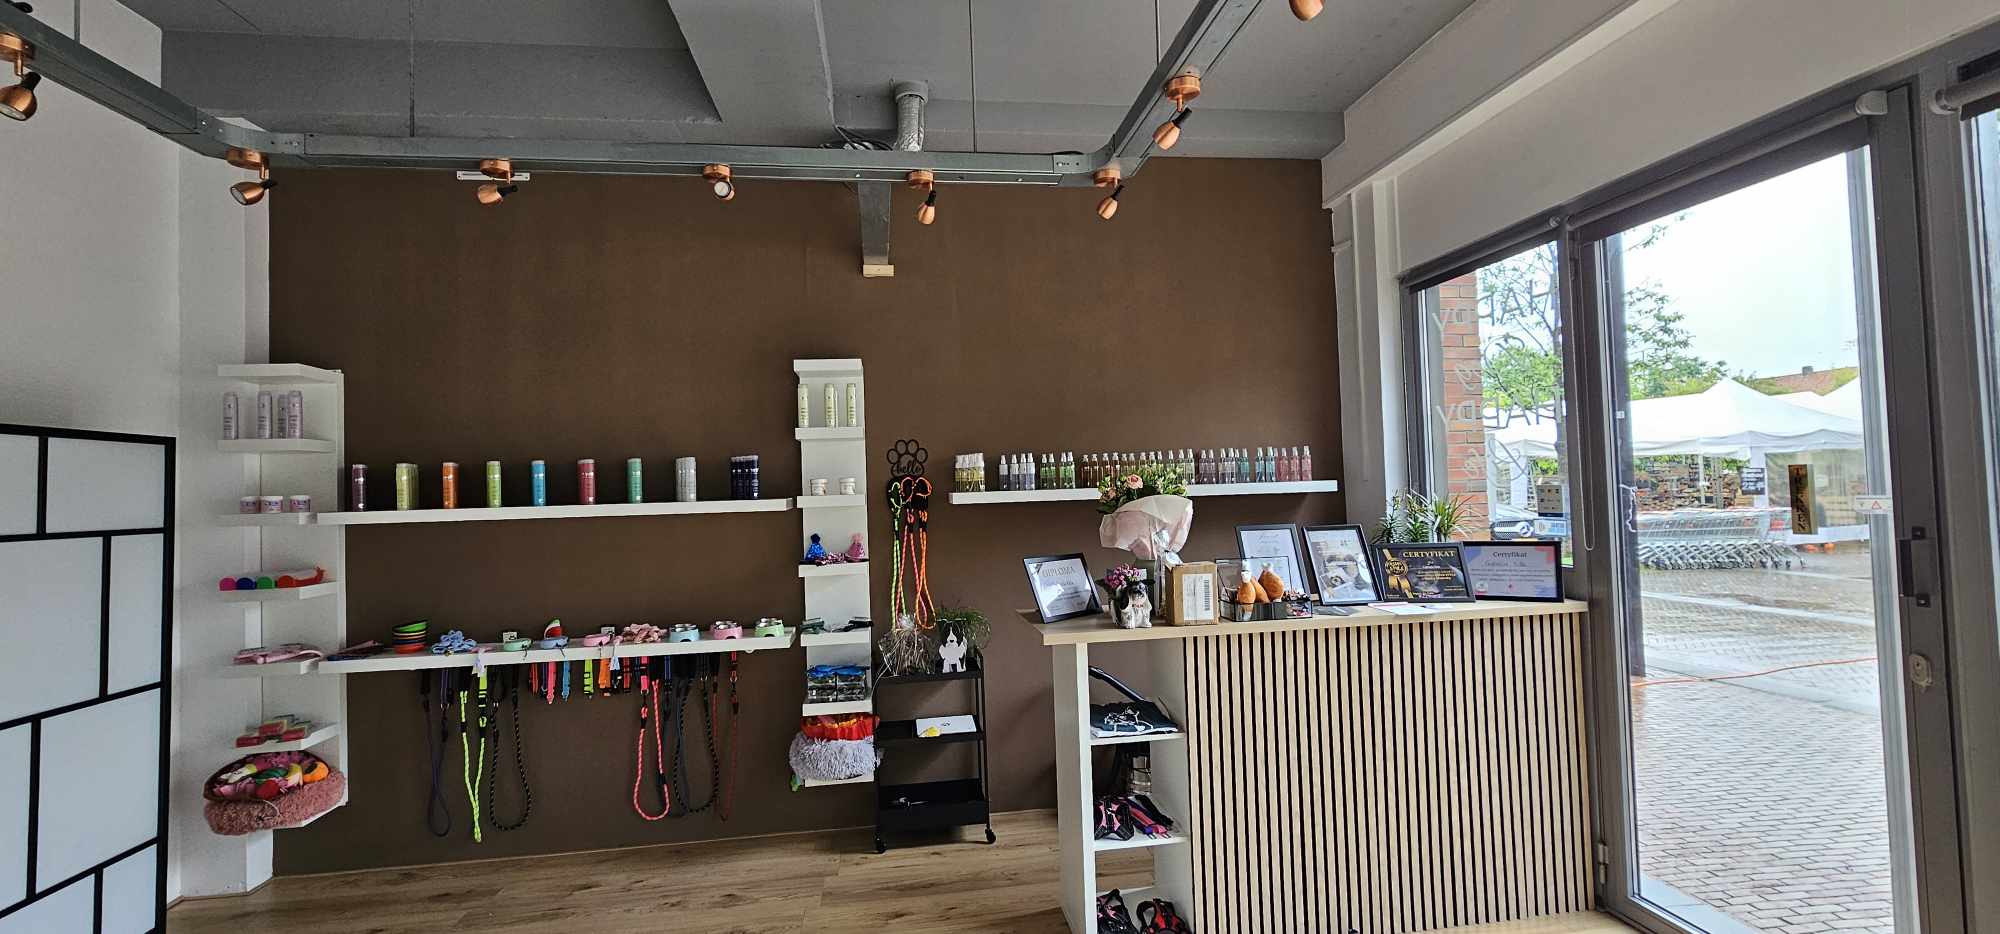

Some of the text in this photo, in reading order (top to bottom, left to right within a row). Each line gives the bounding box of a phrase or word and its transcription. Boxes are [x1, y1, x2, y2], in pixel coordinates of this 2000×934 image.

[1402, 550, 1455, 558] CERTYFIKAT
[1492, 551, 1527, 559] Certyfikat
[1042, 566, 1074, 577] DIPLOMA
